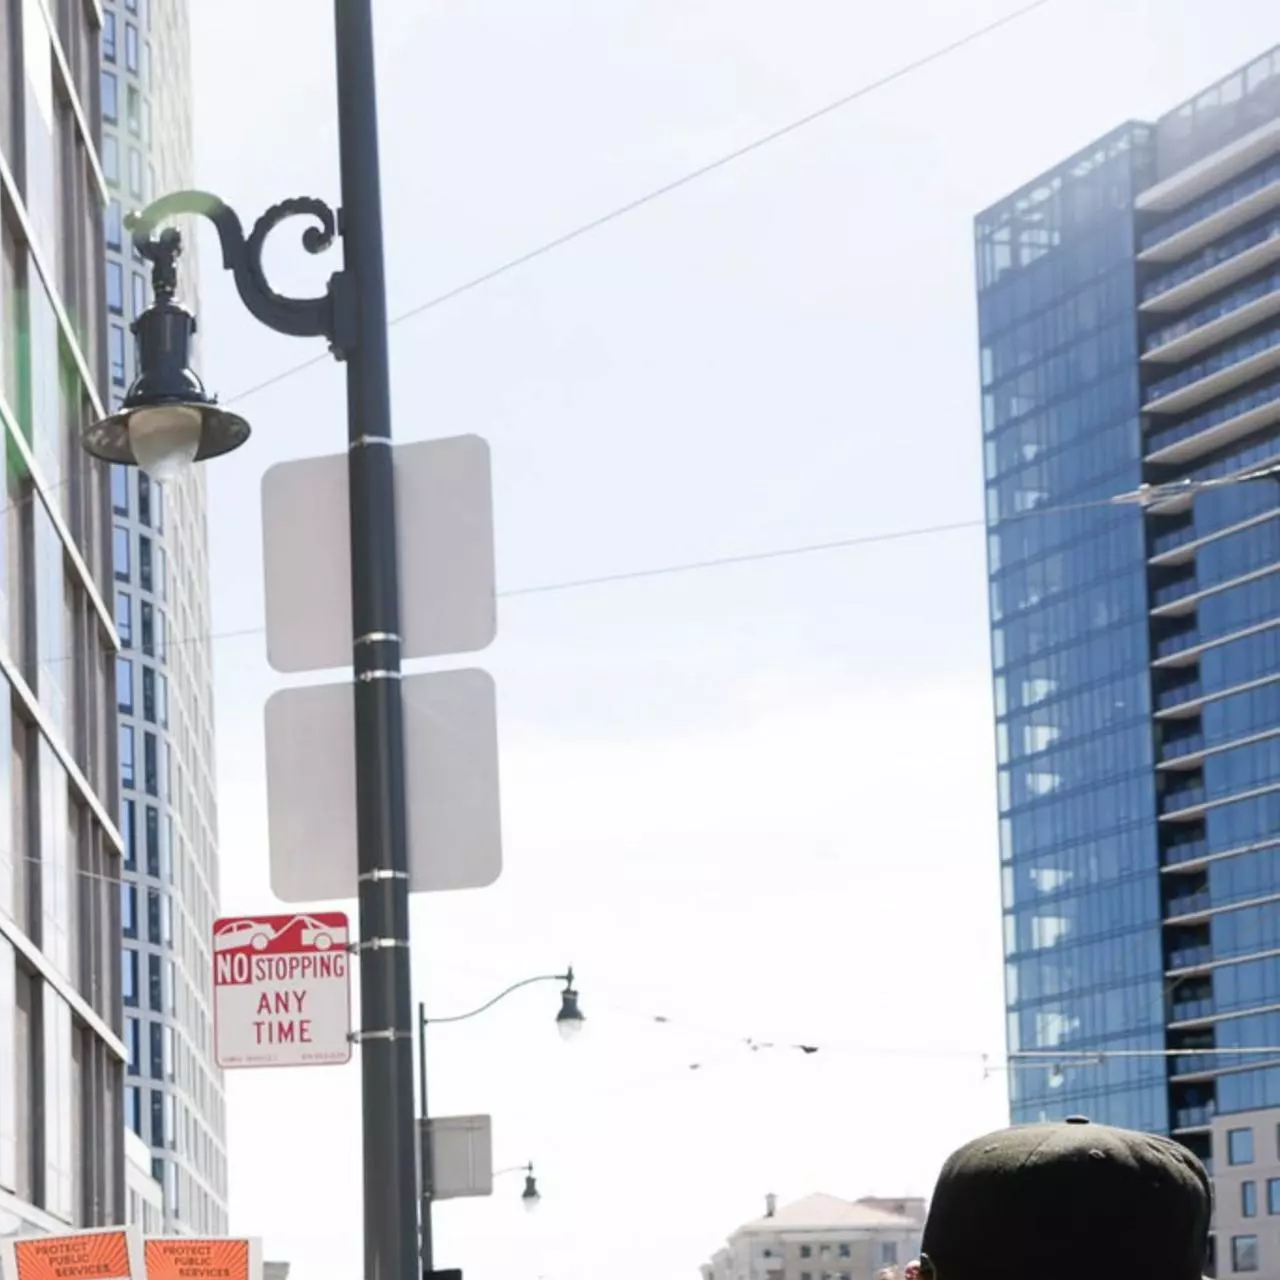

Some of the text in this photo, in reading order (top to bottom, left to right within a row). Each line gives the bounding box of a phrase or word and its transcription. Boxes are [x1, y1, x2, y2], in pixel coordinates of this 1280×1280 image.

[216, 953, 345, 984] NO STOPPING
[256, 990, 308, 1015] ANY
[253, 1020, 313, 1045] TIME
[36, 1243, 87, 1255] PROTECT
[163, 1246, 212, 1256] PROTECT
[48, 1254, 90, 1265] PUBLIC
[174, 1257, 212, 1265] PUBLIC
